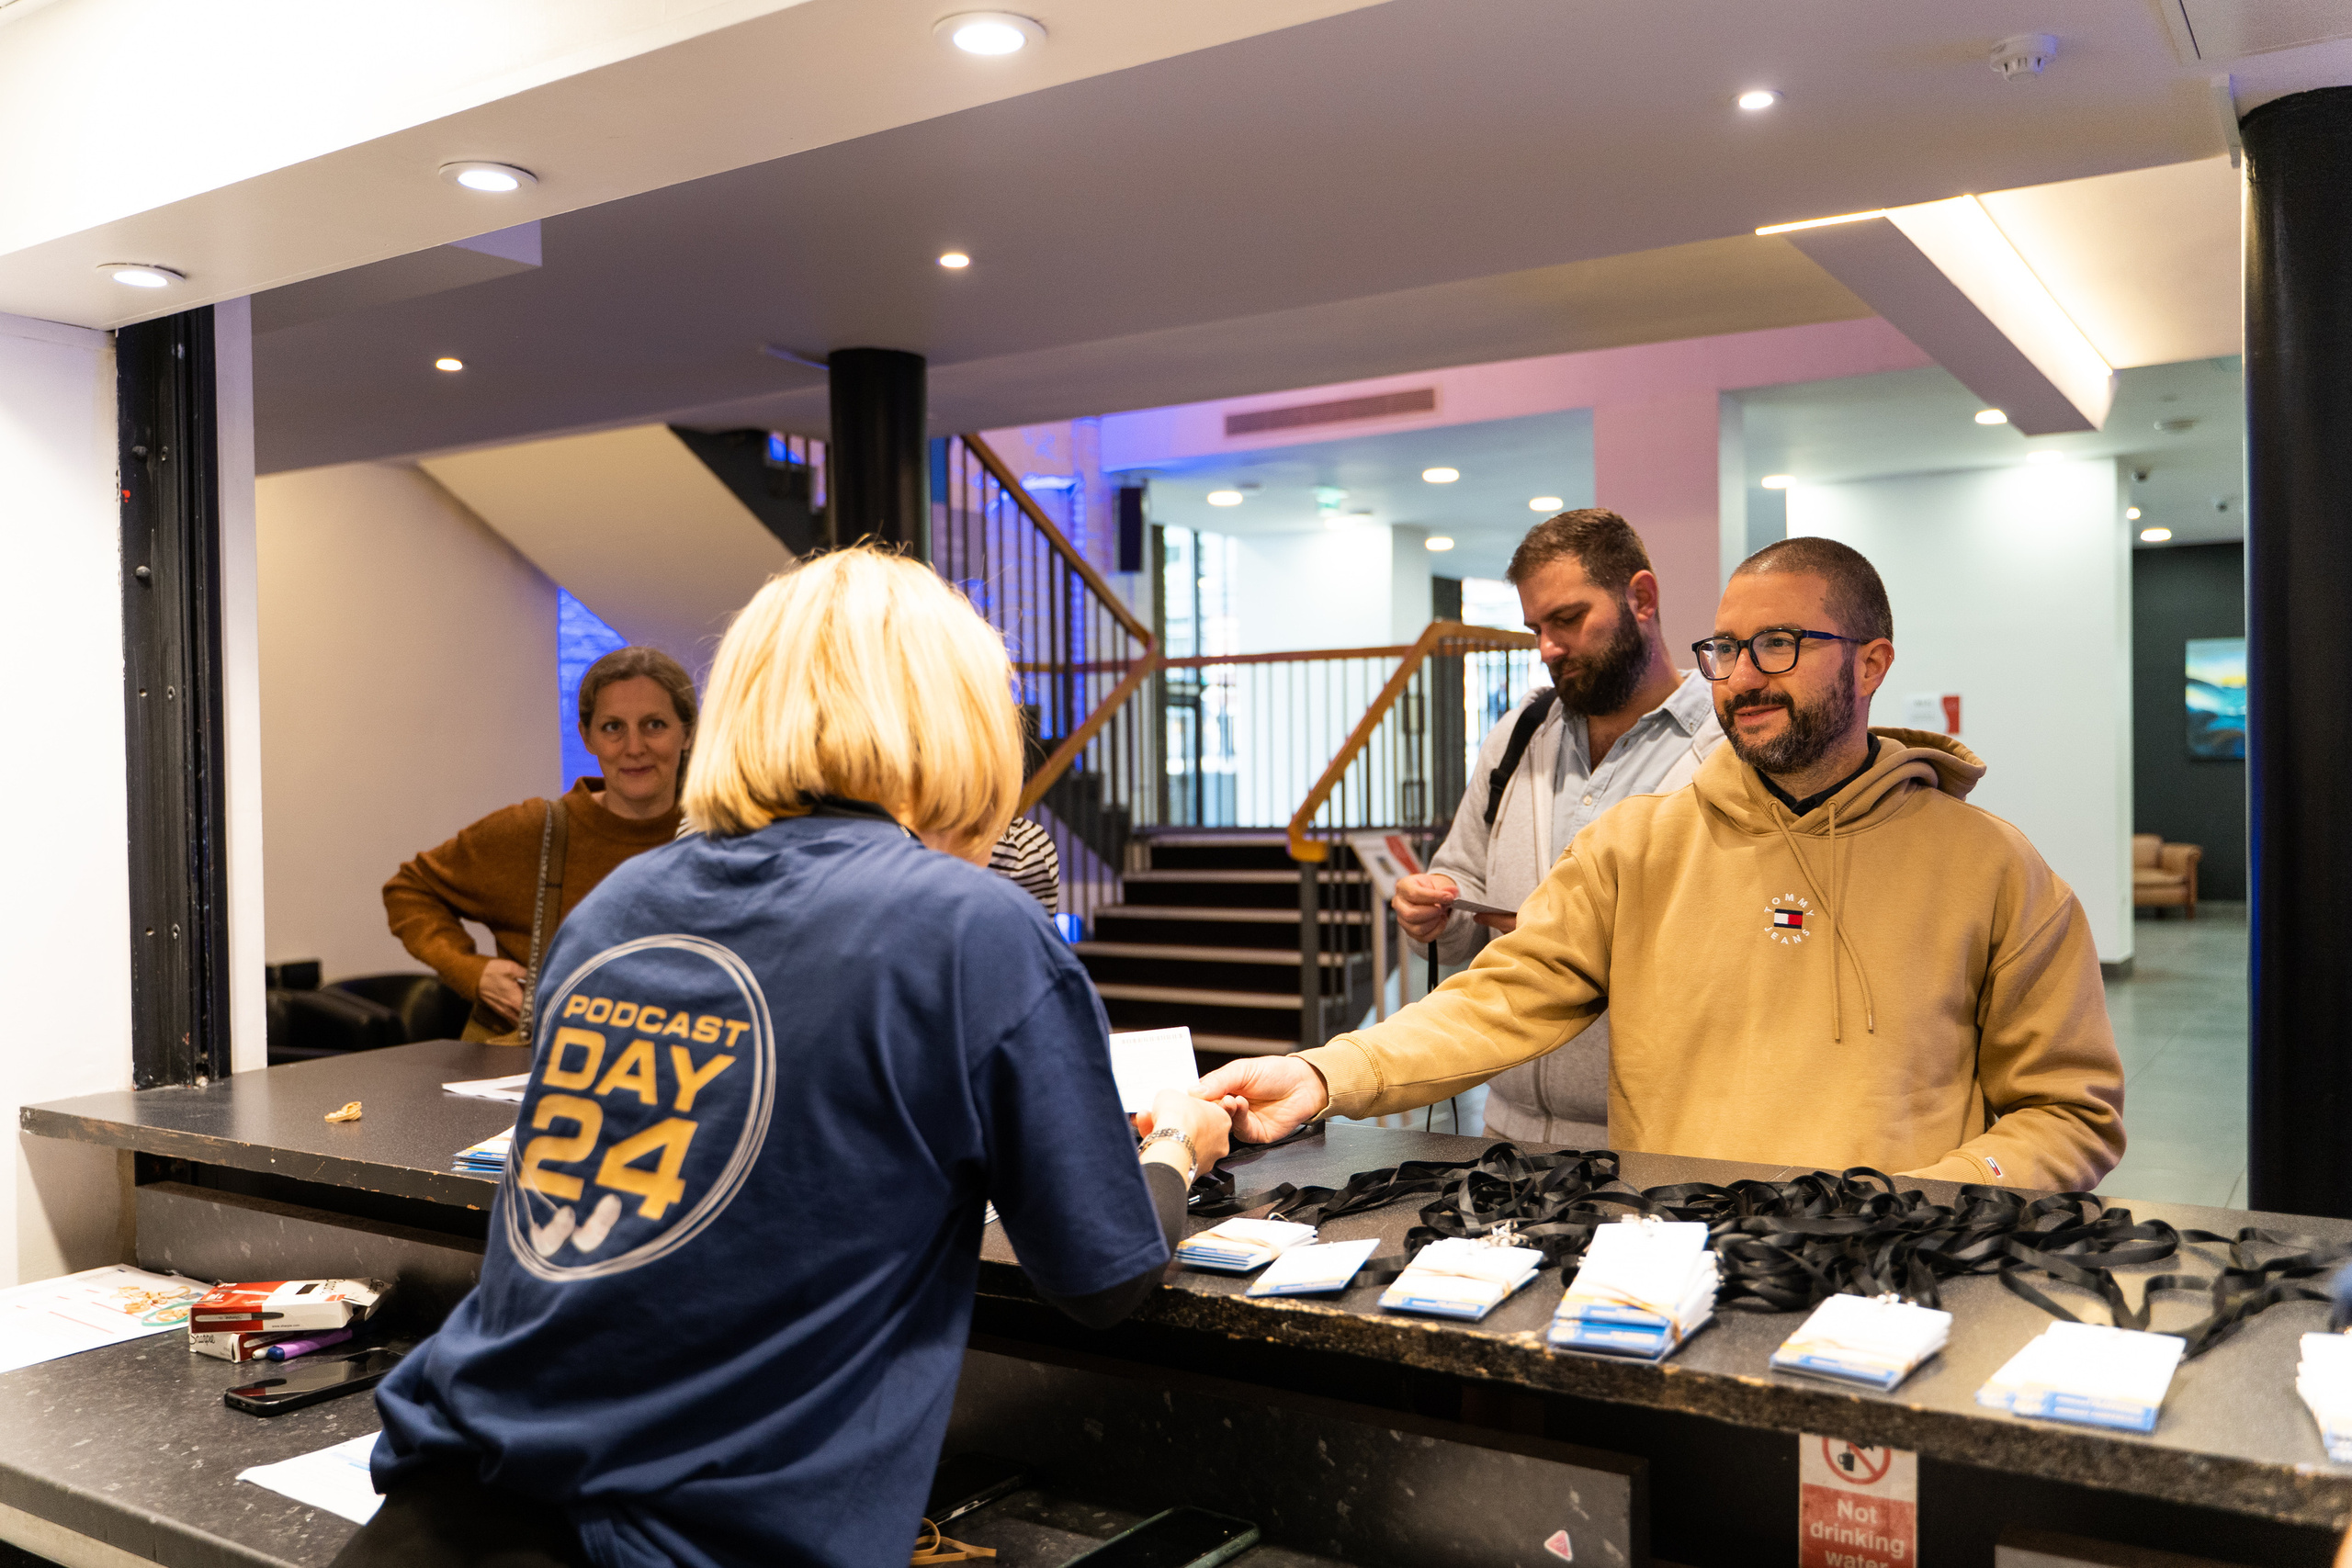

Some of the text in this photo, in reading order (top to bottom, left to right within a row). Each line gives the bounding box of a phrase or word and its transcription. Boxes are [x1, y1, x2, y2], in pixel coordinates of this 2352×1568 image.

[1764, 893, 1815, 917] TOMMY
[1764, 927, 1810, 945] JEANS
[563, 994, 751, 1047] PODCAST
[542, 1026, 737, 1113] DAY
[518, 1093, 699, 1221] 24
[1838, 1499, 1878, 1525] Not
[1810, 1520, 1905, 1560] drinking
